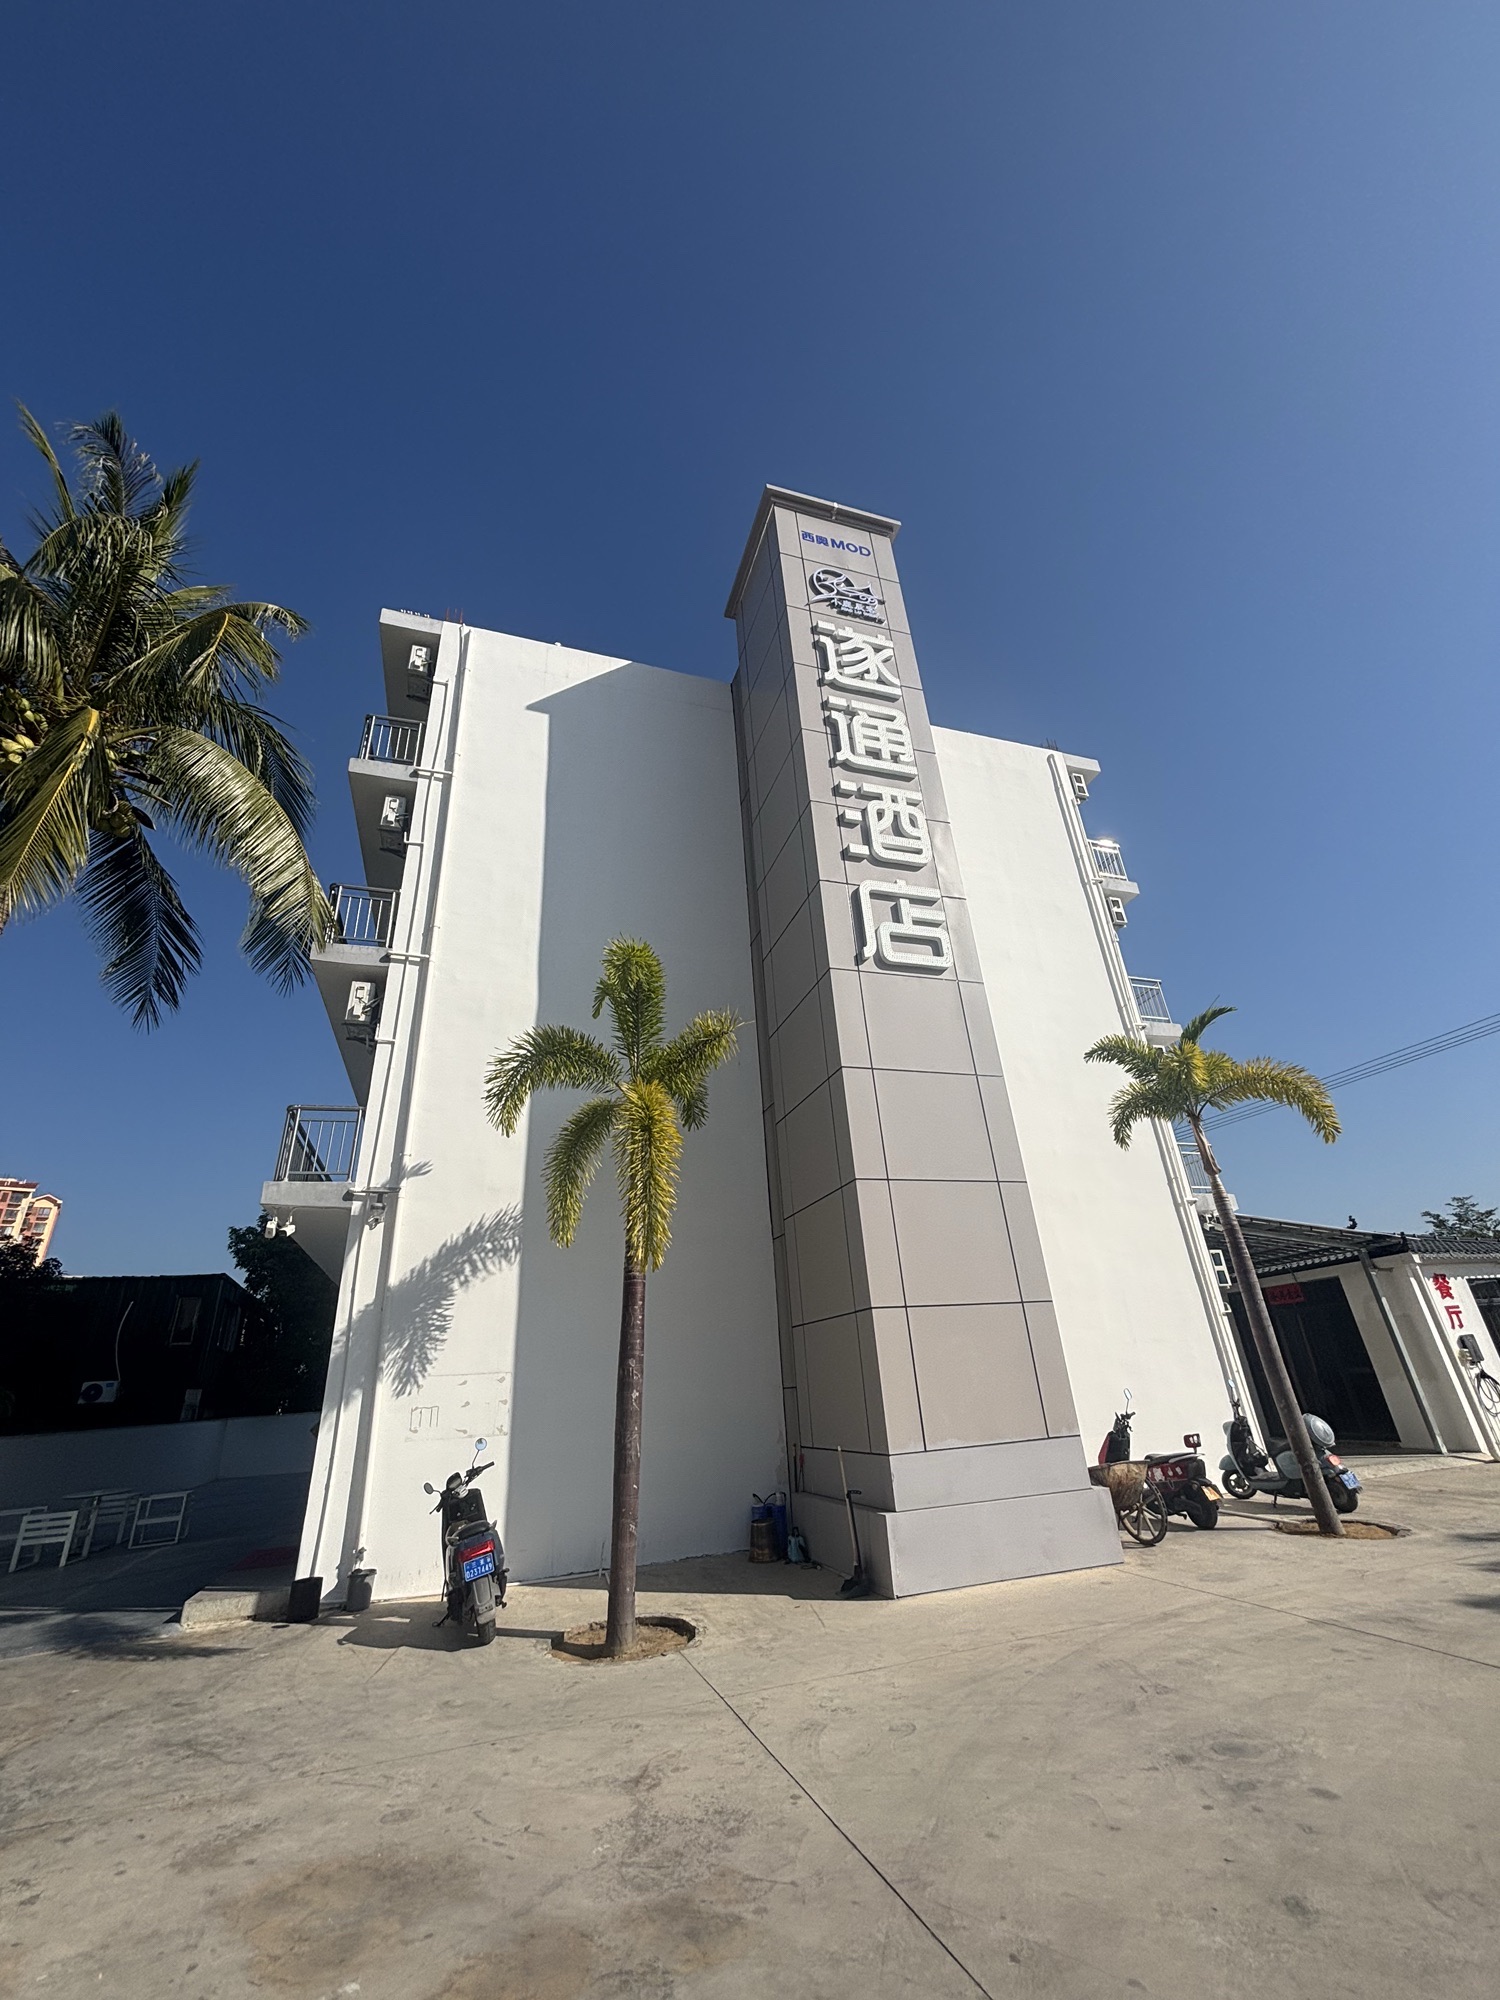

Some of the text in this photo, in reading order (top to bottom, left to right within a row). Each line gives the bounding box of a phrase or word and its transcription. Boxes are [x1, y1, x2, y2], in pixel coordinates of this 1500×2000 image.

[816, 620, 953, 971] 遂通酒店
[1432, 1272, 1464, 1330] 餐厅
